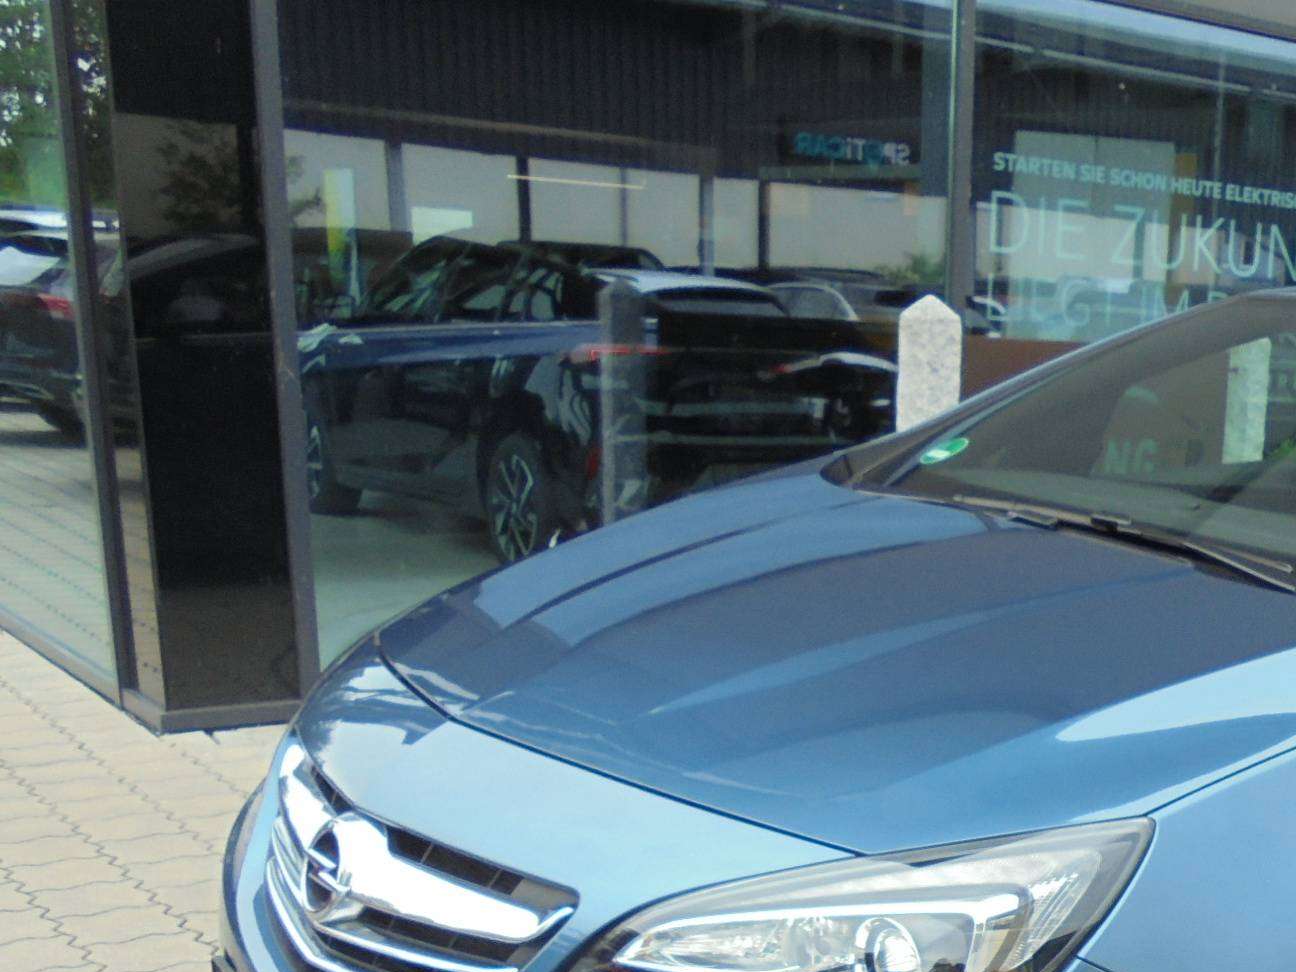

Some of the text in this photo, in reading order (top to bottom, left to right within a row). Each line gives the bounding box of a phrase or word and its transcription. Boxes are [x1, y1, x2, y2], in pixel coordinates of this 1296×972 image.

[993, 152, 1077, 182] STARTEN
[1079, 165, 1107, 185] SIE
[1110, 169, 1168, 193] SCHON
[1170, 178, 1223, 200] HEUTE
[989, 190, 1089, 260] DIE
